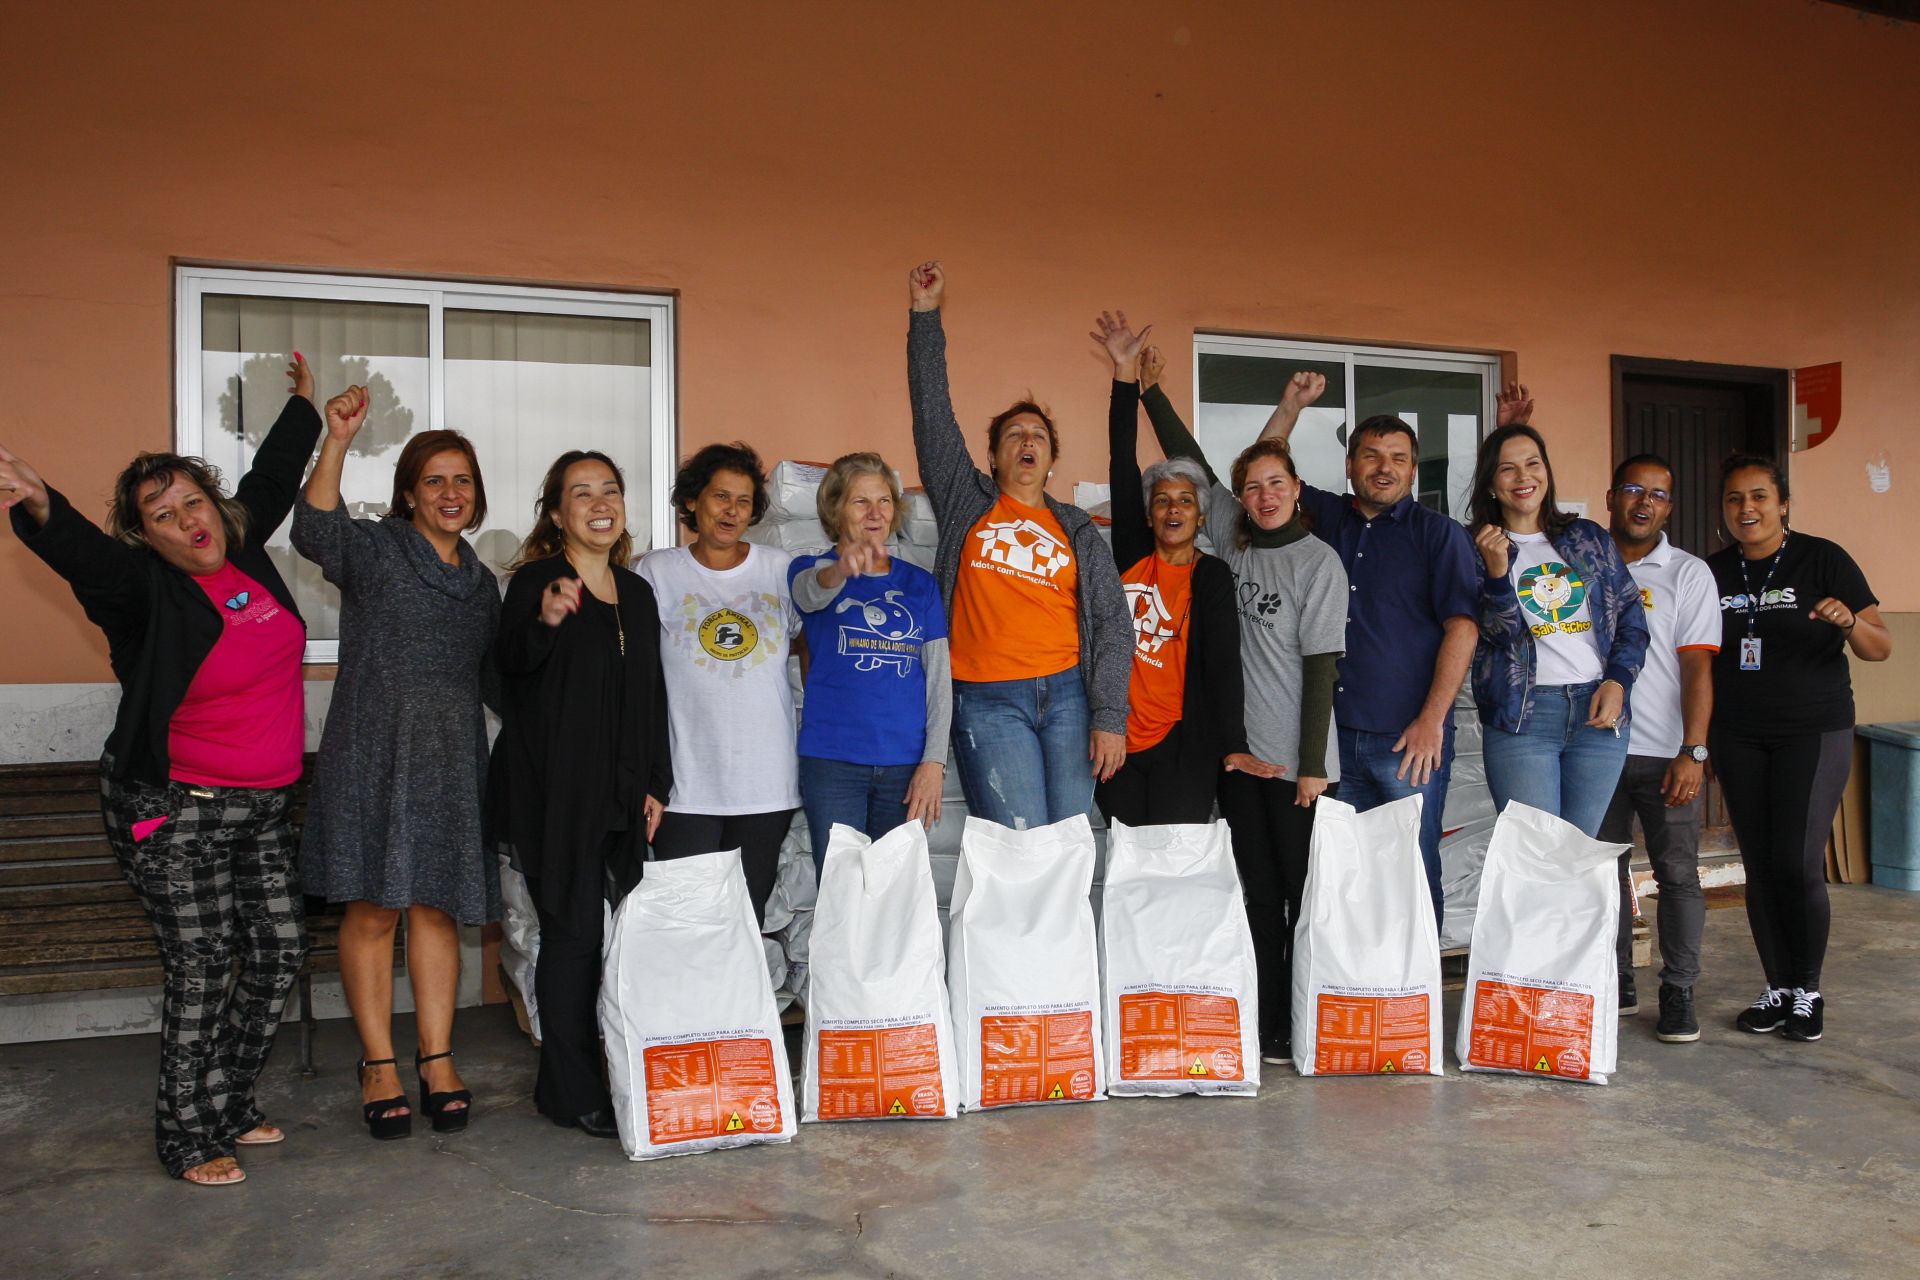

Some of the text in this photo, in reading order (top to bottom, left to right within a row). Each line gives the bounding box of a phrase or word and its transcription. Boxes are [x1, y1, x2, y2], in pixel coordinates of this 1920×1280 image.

[970, 560, 995, 571] Adote
[997, 566, 1015, 576] com
[725, 610, 753, 629] ANIMAL
[1194, 1064, 1202, 1072] T
[1539, 1061, 1547, 1070] T
[1054, 1089, 1060, 1097] T
[732, 1119, 739, 1128] T
